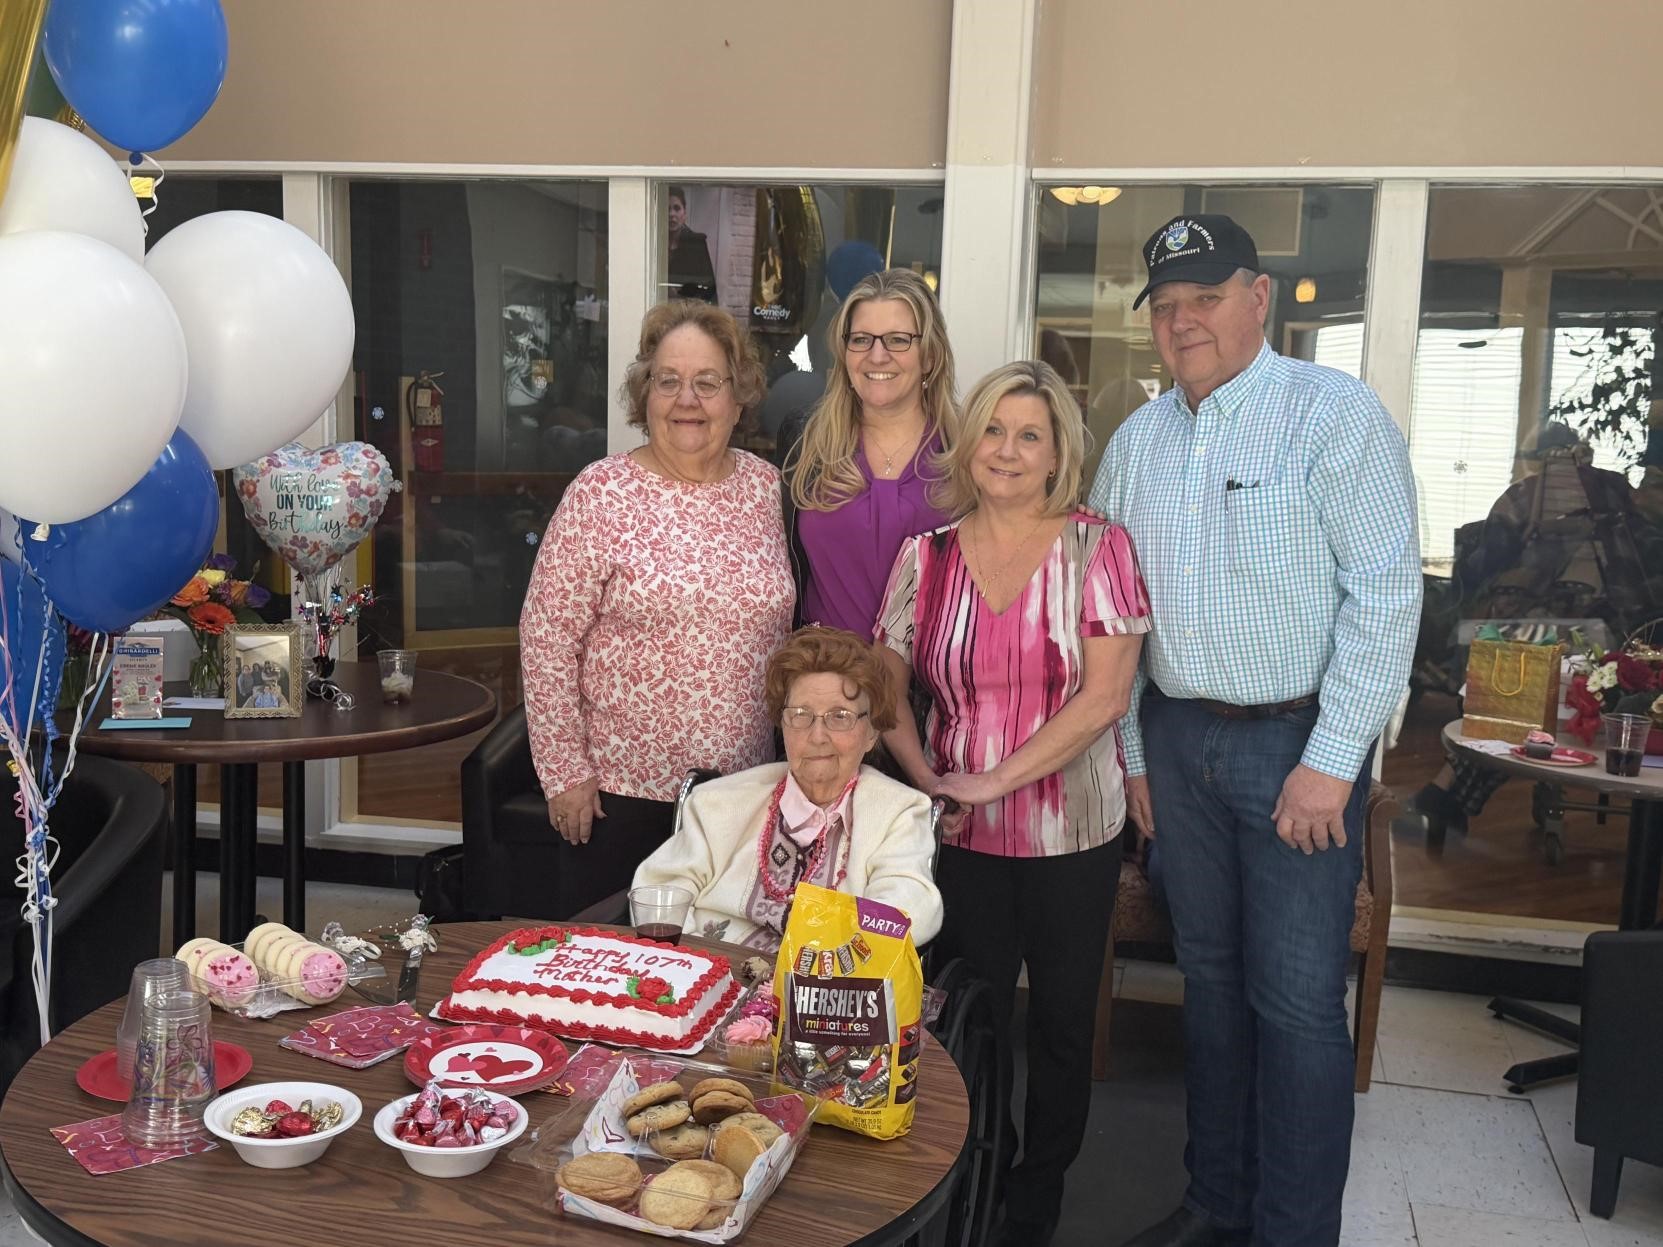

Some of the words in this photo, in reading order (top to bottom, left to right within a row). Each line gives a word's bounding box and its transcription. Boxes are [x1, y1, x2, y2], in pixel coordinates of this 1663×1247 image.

[1168, 219, 1185, 232] and
[1187, 219, 1215, 251] Farmers
[1158, 256, 1165, 264] of
[1166, 247, 1200, 260] Missouri
[753, 306, 791, 320] Comedy
[276, 494, 294, 510] ON
[298, 494, 333, 511] YOUR
[861, 914, 901, 934] PARTY
[555, 943, 631, 963] Happy
[536, 953, 650, 980] Birthday
[796, 985, 879, 1019] HERSHEY'S
[805, 1017, 869, 1032] miniatures
